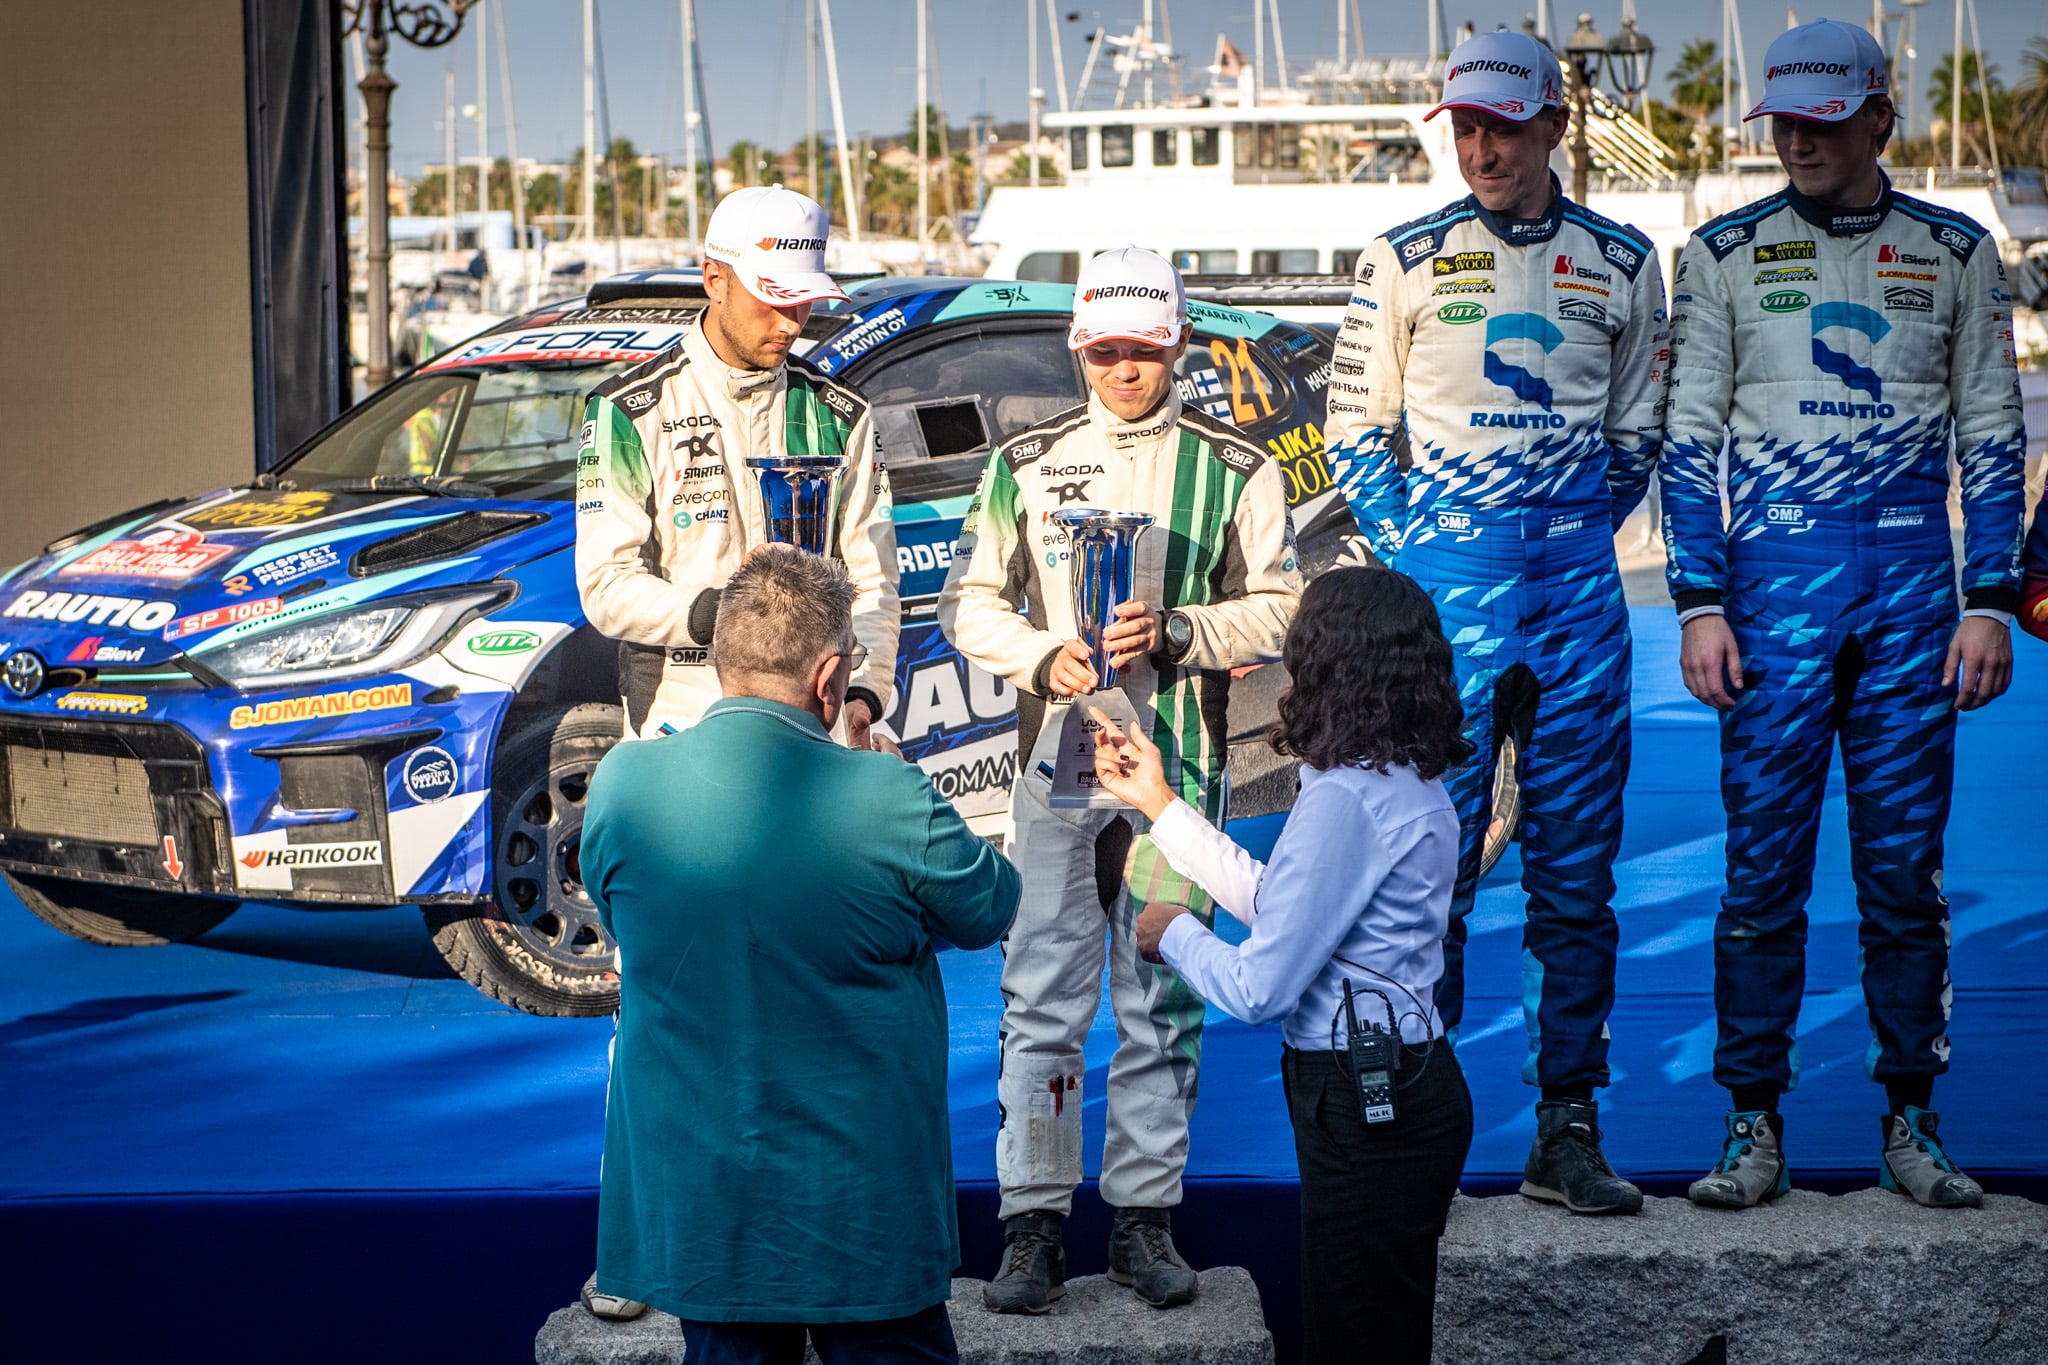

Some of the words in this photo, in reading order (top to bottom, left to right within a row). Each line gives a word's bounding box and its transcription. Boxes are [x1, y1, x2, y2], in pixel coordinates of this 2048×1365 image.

[1716, 230, 1747, 247] OMP
[1940, 230, 1969, 249] OMP
[1404, 240, 1434, 257] OMP
[1606, 244, 1636, 266] OMP
[1776, 248, 1815, 260] WOOD
[1455, 253, 1493, 262] ANAIKA
[1455, 260, 1494, 271] WOOD
[1901, 254, 1941, 267] Sievi
[1576, 267, 1612, 284] Sievi
[888, 316, 908, 341] OY
[1210, 336, 1275, 424] 21
[626, 391, 653, 408] OMP
[826, 391, 853, 413] OMP
[1799, 400, 1896, 419] RAUTIO
[1469, 412, 1567, 430] RAUTIO
[1012, 442, 1043, 459] OMP
[1223, 447, 1254, 466] OMP
[672, 489, 731, 505] evecon
[695, 509, 729, 522] CHANZ
[1438, 515, 1471, 529] OMP
[1767, 508, 1803, 521] OMP
[253, 545, 331, 577] RESPECT
[259, 552, 338, 586] PROJECT
[3, 590, 177, 631] RAUTIO
[183, 611, 220, 633] SP
[228, 600, 280, 621] 1003
[470, 631, 542, 649] VIITA
[94, 646, 145, 662] Sievi
[671, 650, 708, 663] OMP
[231, 684, 411, 728] SJOMAN.COM
